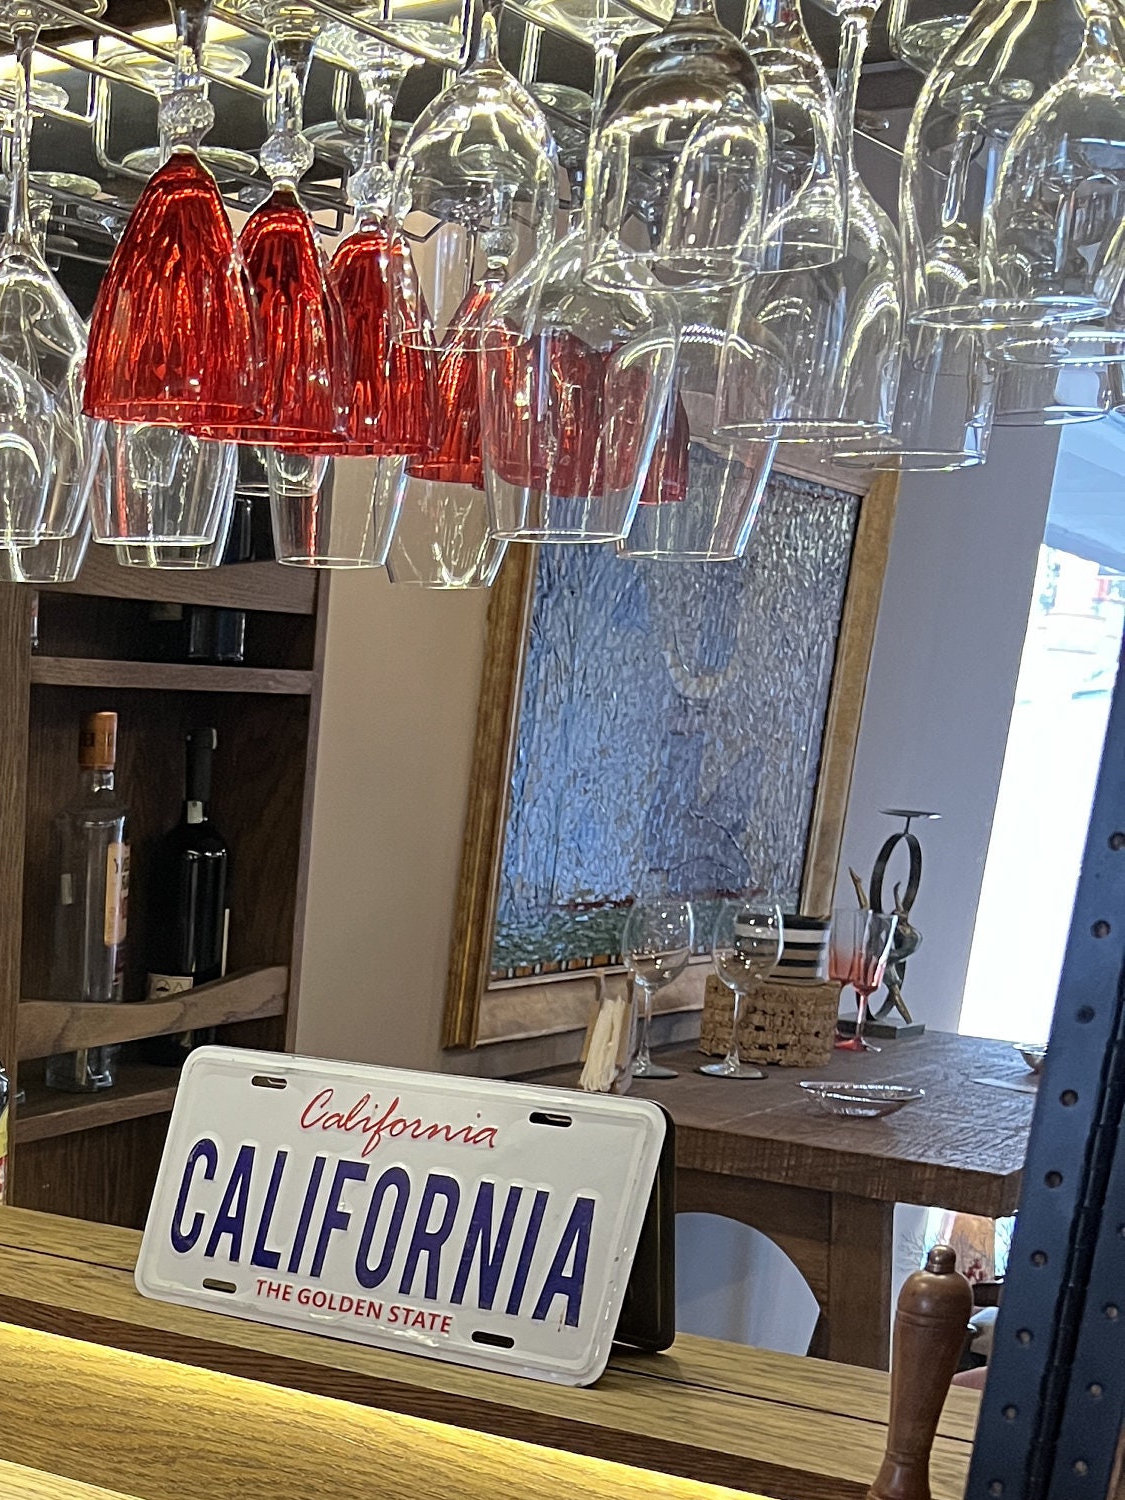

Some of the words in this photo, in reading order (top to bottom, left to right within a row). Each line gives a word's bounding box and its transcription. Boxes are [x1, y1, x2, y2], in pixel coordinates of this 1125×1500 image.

[301, 1088, 499, 1158] California
[170, 1138, 595, 1327] CALIFORNIA
[255, 1279, 293, 1301] THE
[297, 1288, 383, 1320] GOLDEN
[388, 1305, 453, 1335] STATE
